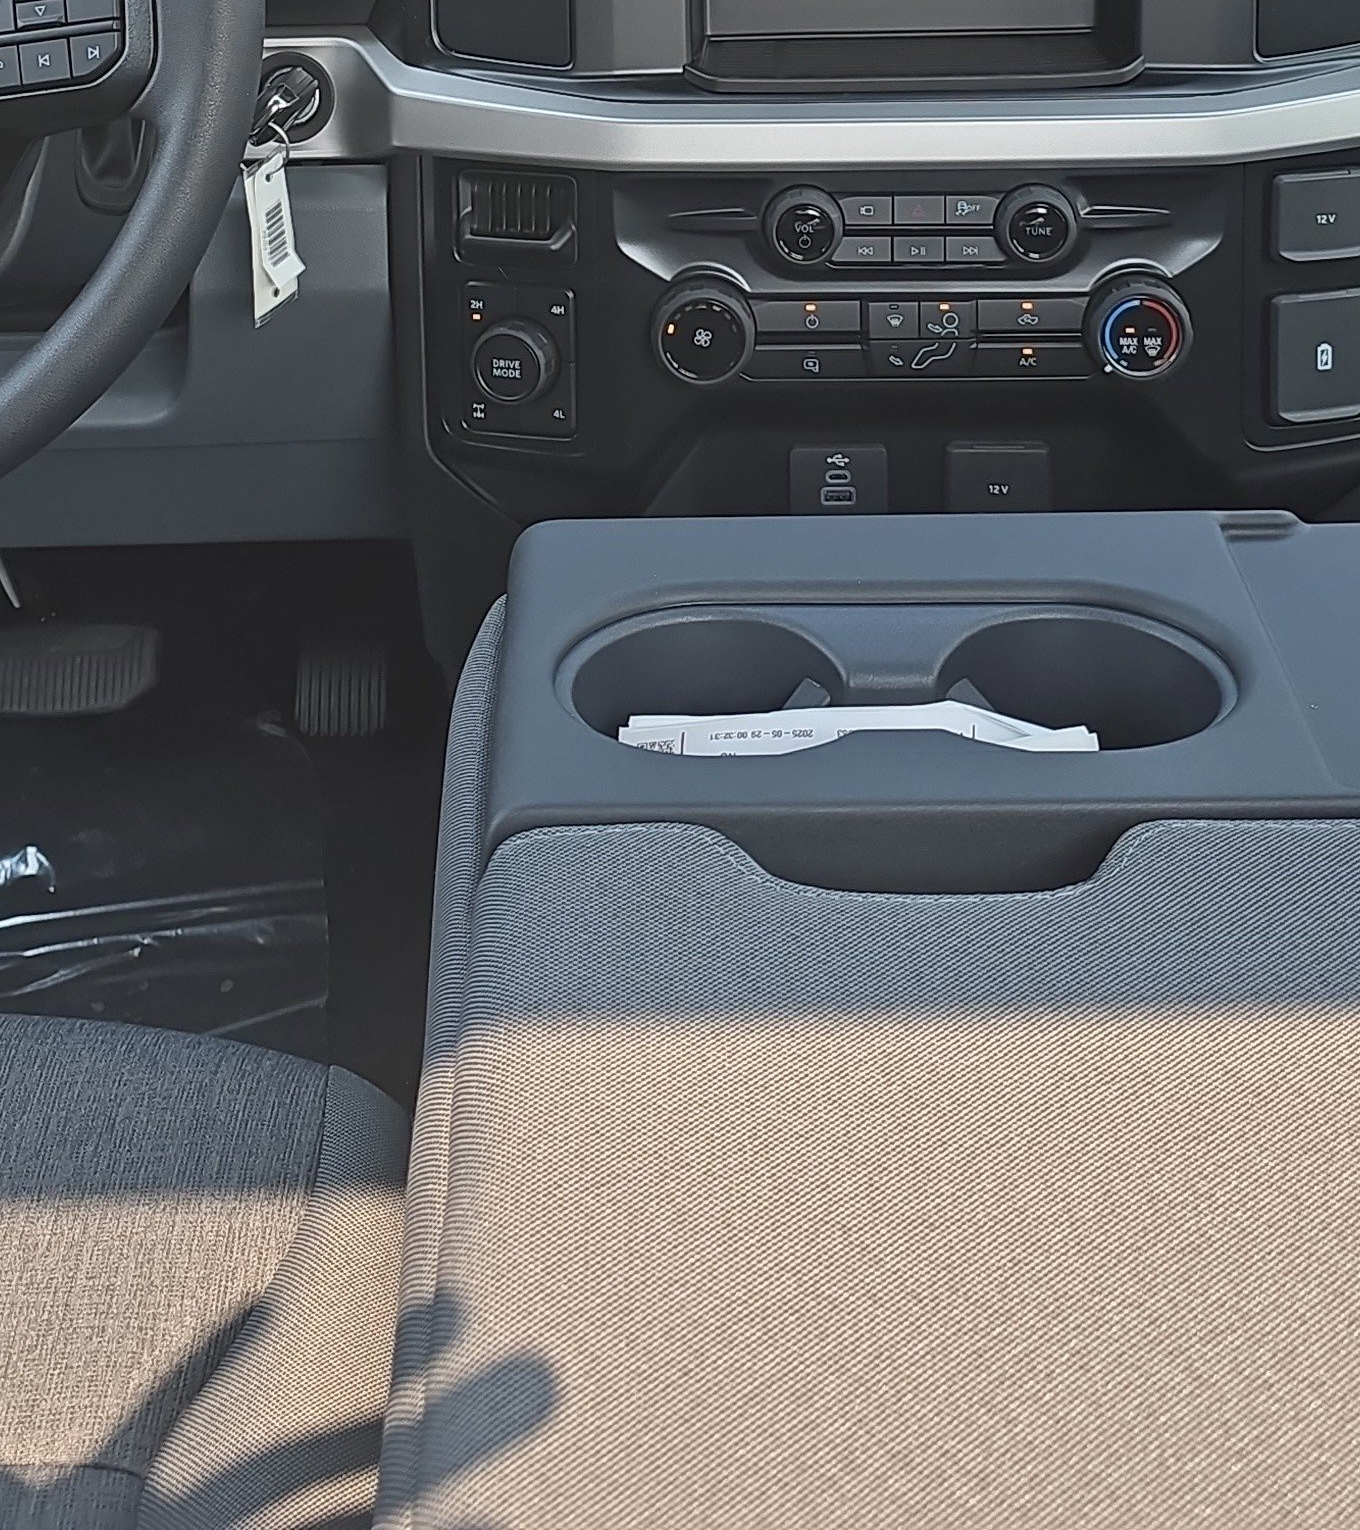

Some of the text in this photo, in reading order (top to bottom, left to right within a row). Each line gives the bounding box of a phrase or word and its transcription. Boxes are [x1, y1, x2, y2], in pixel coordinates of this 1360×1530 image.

[794, 225, 815, 235] VOL
[1025, 226, 1052, 236] TUNE
[470, 300, 484, 310] 2H
[550, 305, 565, 315] 4H
[1119, 337, 1138, 346] MAX
[1143, 337, 1162, 346] MAX
[1121, 346, 1137, 355] A/C
[492, 359, 521, 369] DRIVE
[1020, 357, 1037, 367] A/C
[492, 368, 522, 379] MODE
[553, 409, 566, 419] 4L
